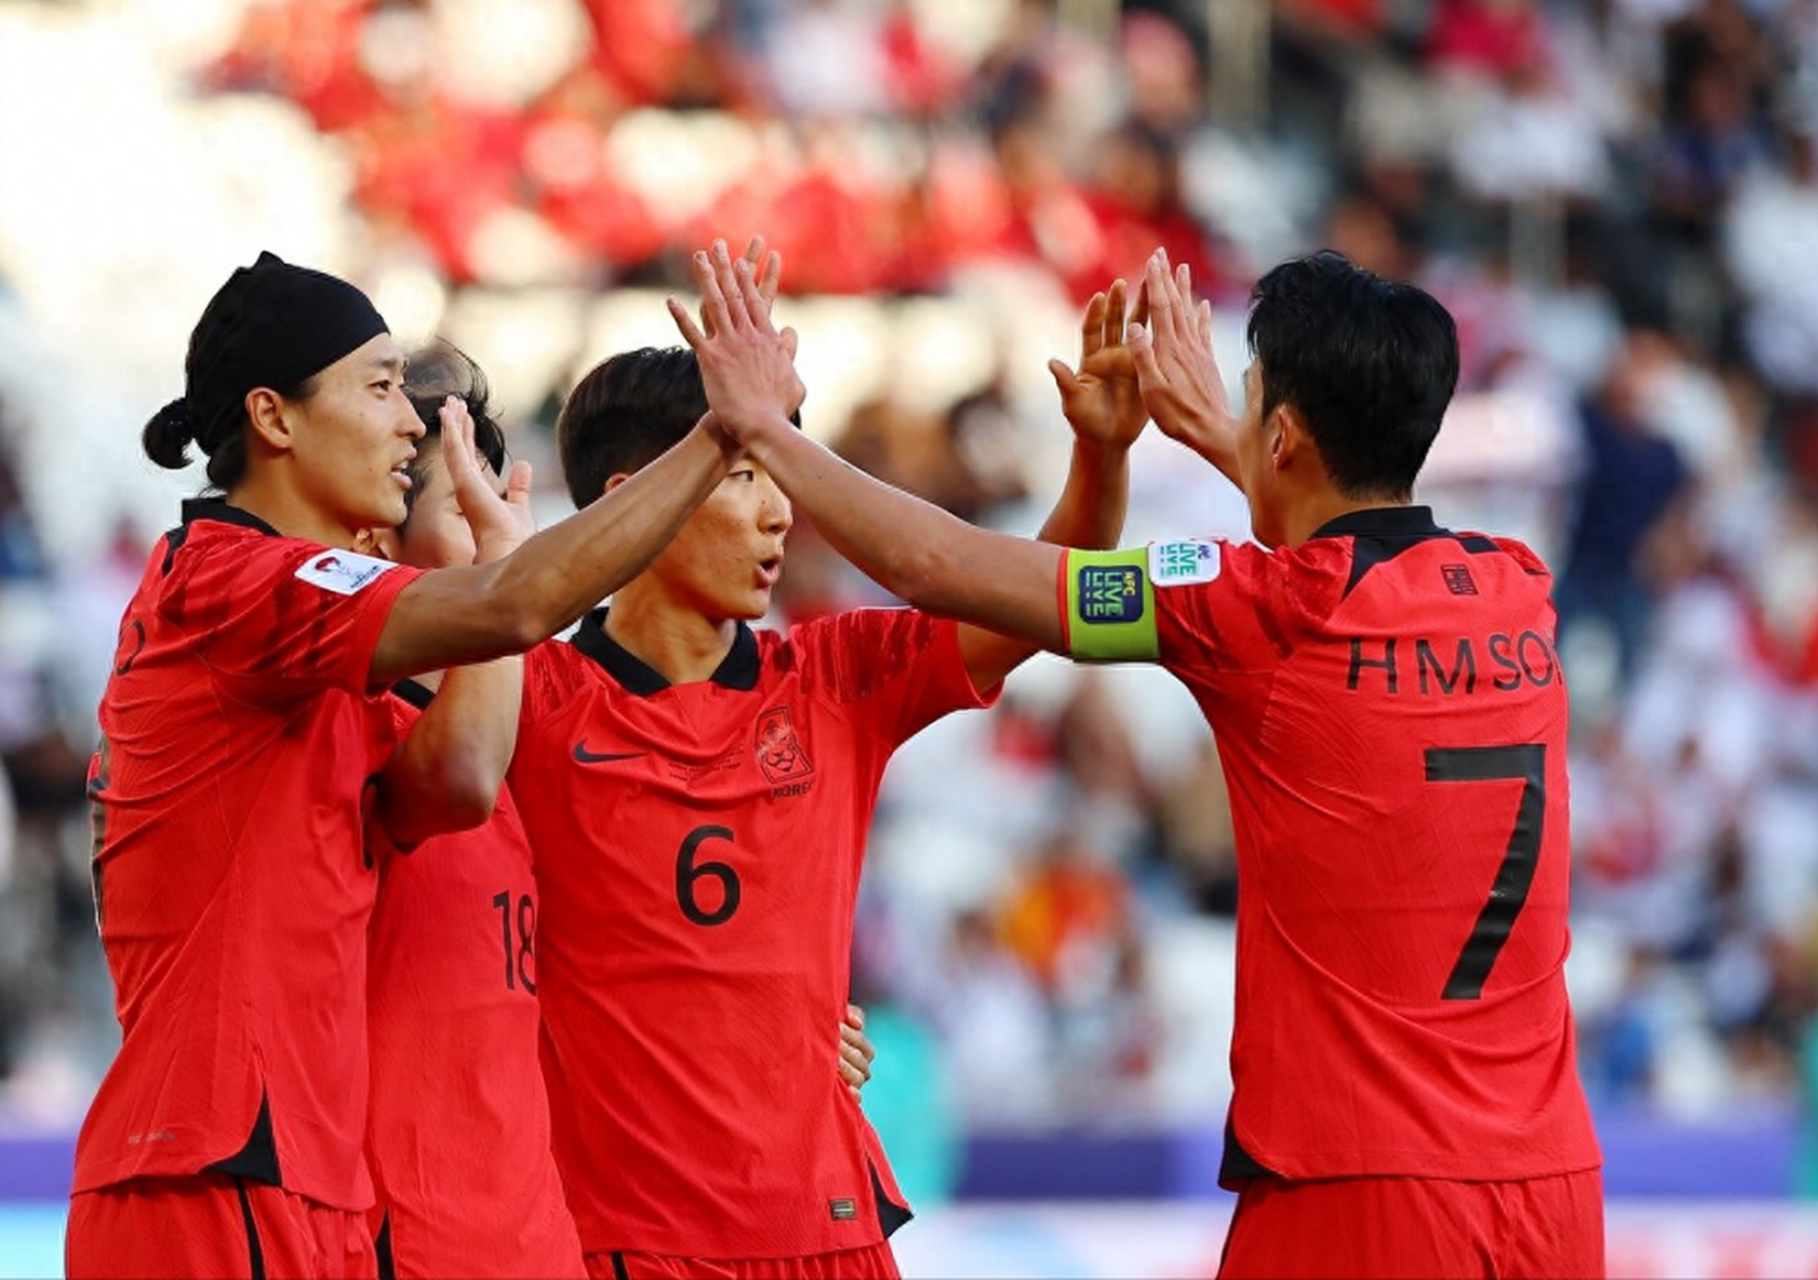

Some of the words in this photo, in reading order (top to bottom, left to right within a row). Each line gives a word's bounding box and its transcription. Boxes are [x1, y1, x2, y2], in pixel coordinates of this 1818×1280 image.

[1123, 571, 1135, 596] AFC
[1180, 543, 1196, 576] LIVE
[1105, 572, 1123, 615] LIVE
[1347, 637, 1396, 692] H
[1416, 639, 1476, 695] M
[676, 825, 740, 926] 6
[1424, 744, 1546, 1000] 7
[492, 890, 537, 996] 18
